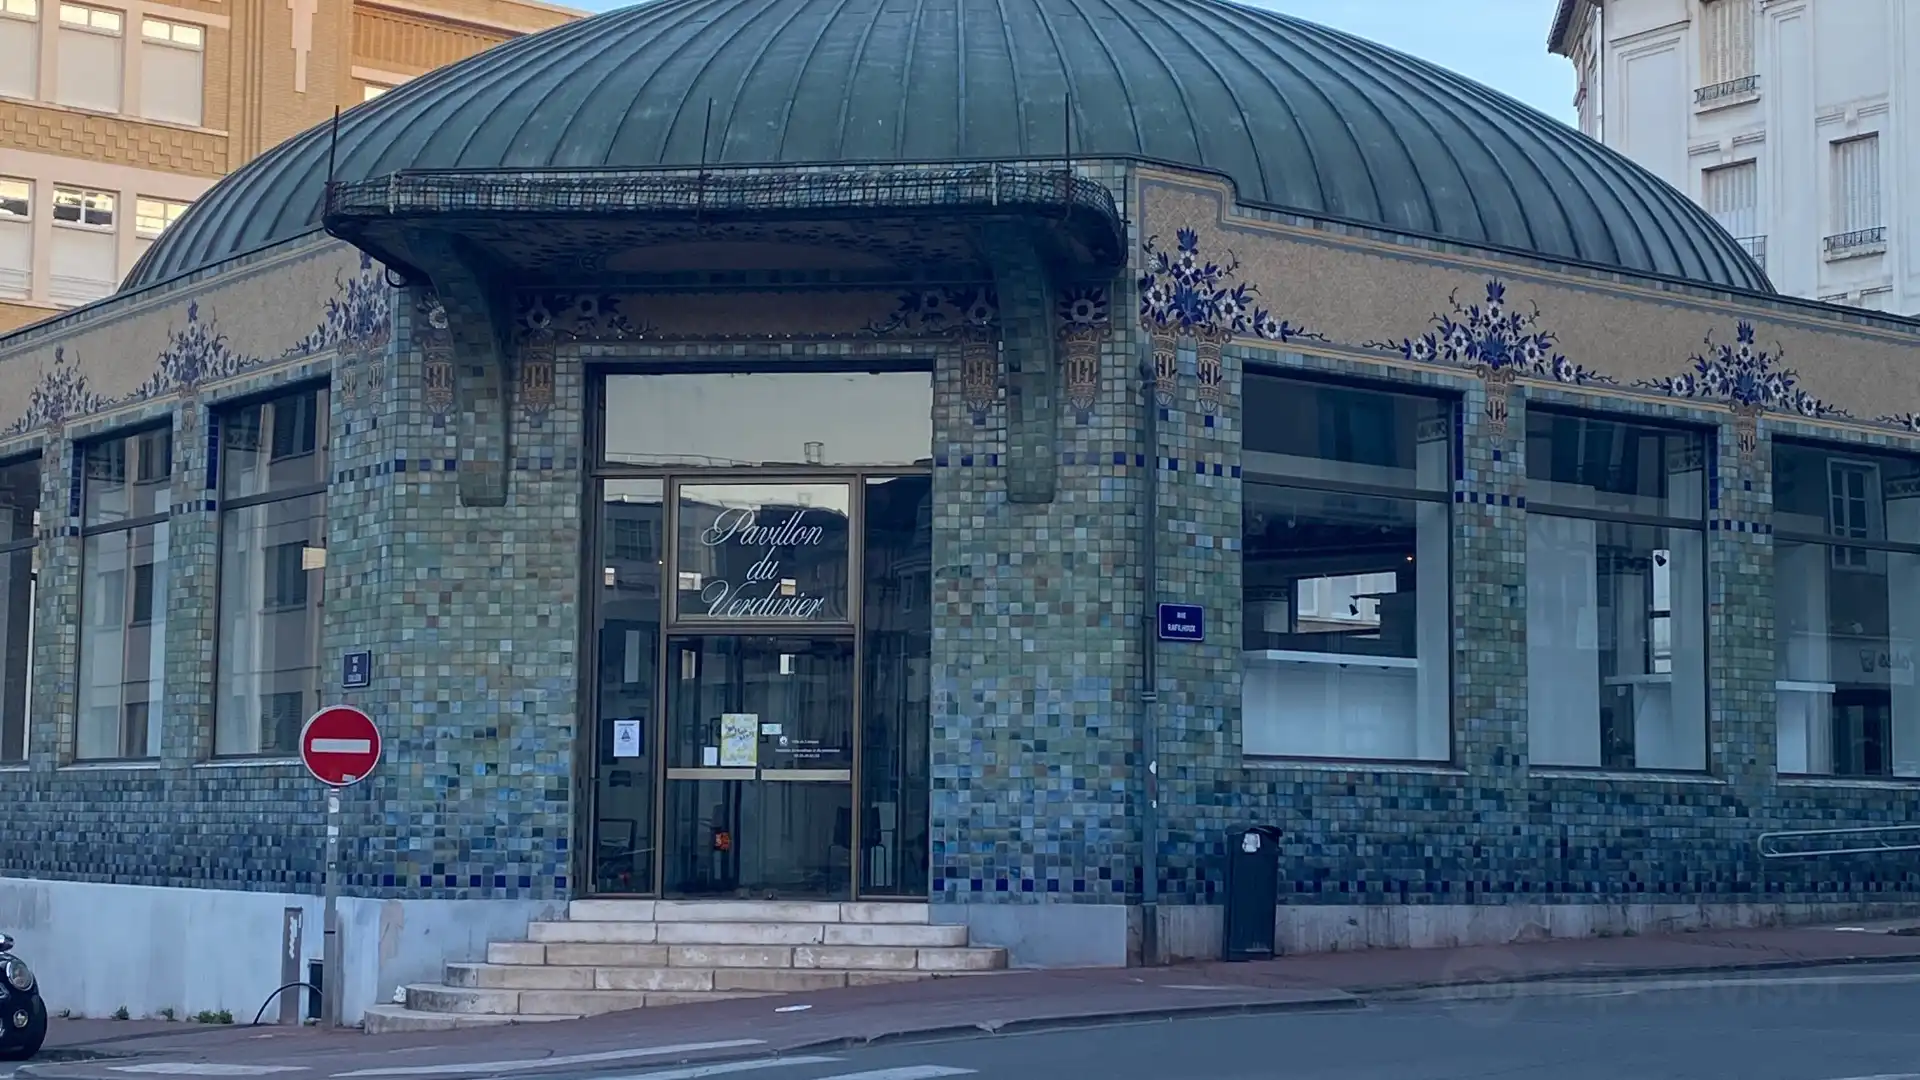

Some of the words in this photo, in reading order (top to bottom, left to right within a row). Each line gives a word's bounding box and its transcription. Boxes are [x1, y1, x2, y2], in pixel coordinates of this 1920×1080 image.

[701, 507, 824, 546] Pavillon
[746, 546, 779, 580] du
[701, 580, 824, 618] Verdurier
